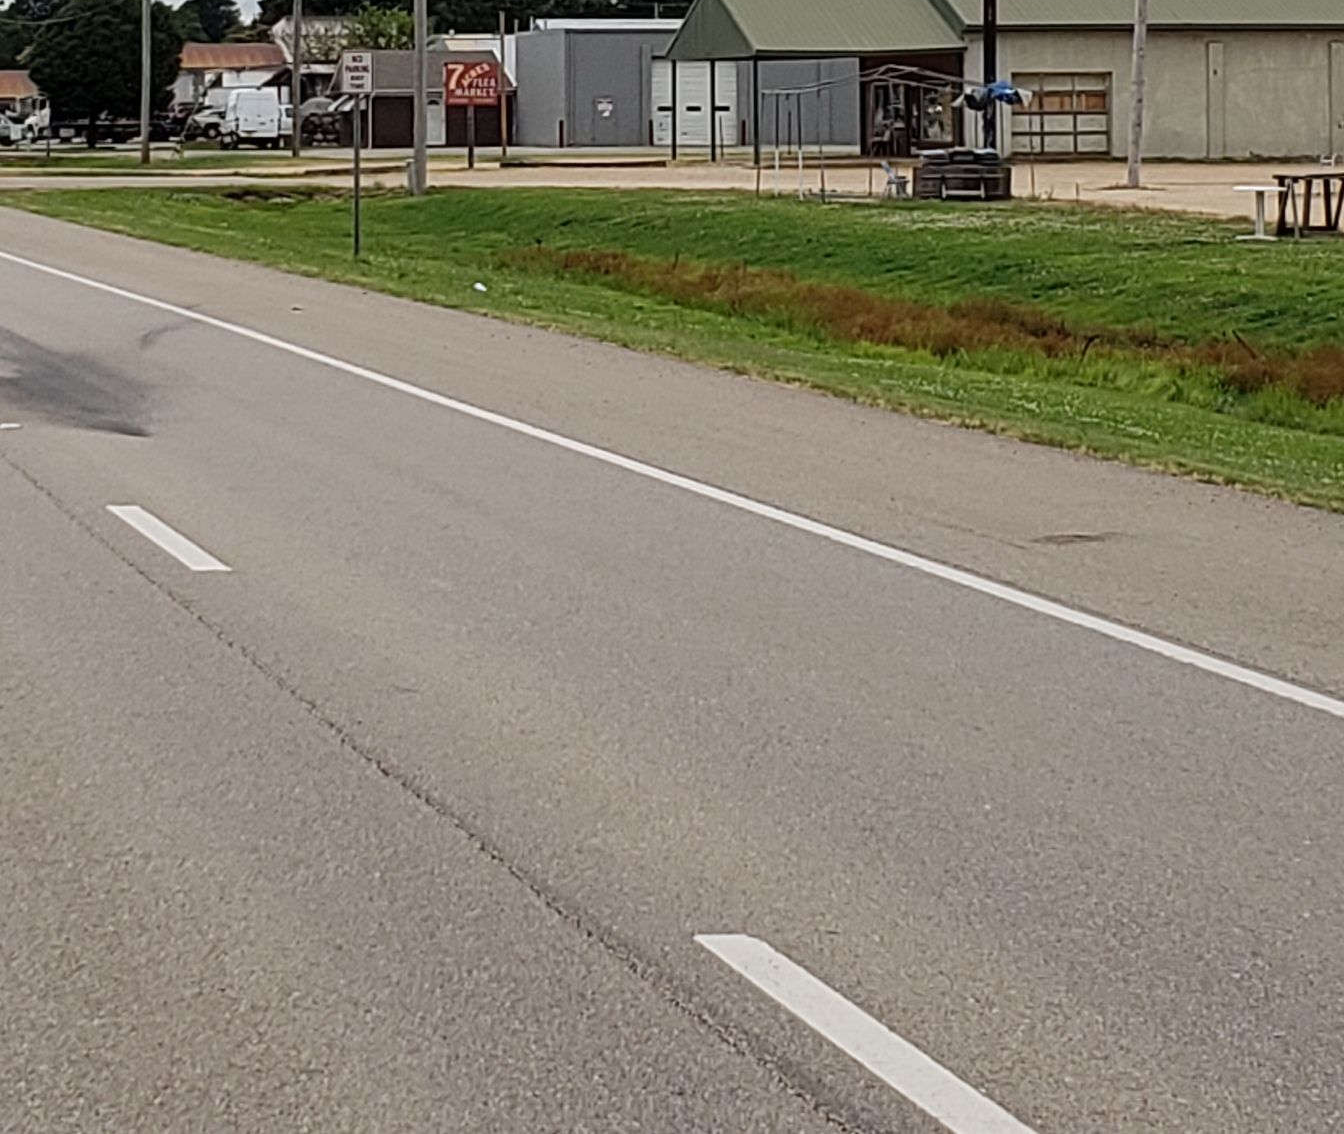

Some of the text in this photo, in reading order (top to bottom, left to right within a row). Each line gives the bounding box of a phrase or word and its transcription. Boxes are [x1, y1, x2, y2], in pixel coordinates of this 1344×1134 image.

[352, 55, 363, 63] NO
[447, 63, 464, 90] 7
[472, 78, 496, 87] FLEA
[454, 88, 496, 97] MARKET
